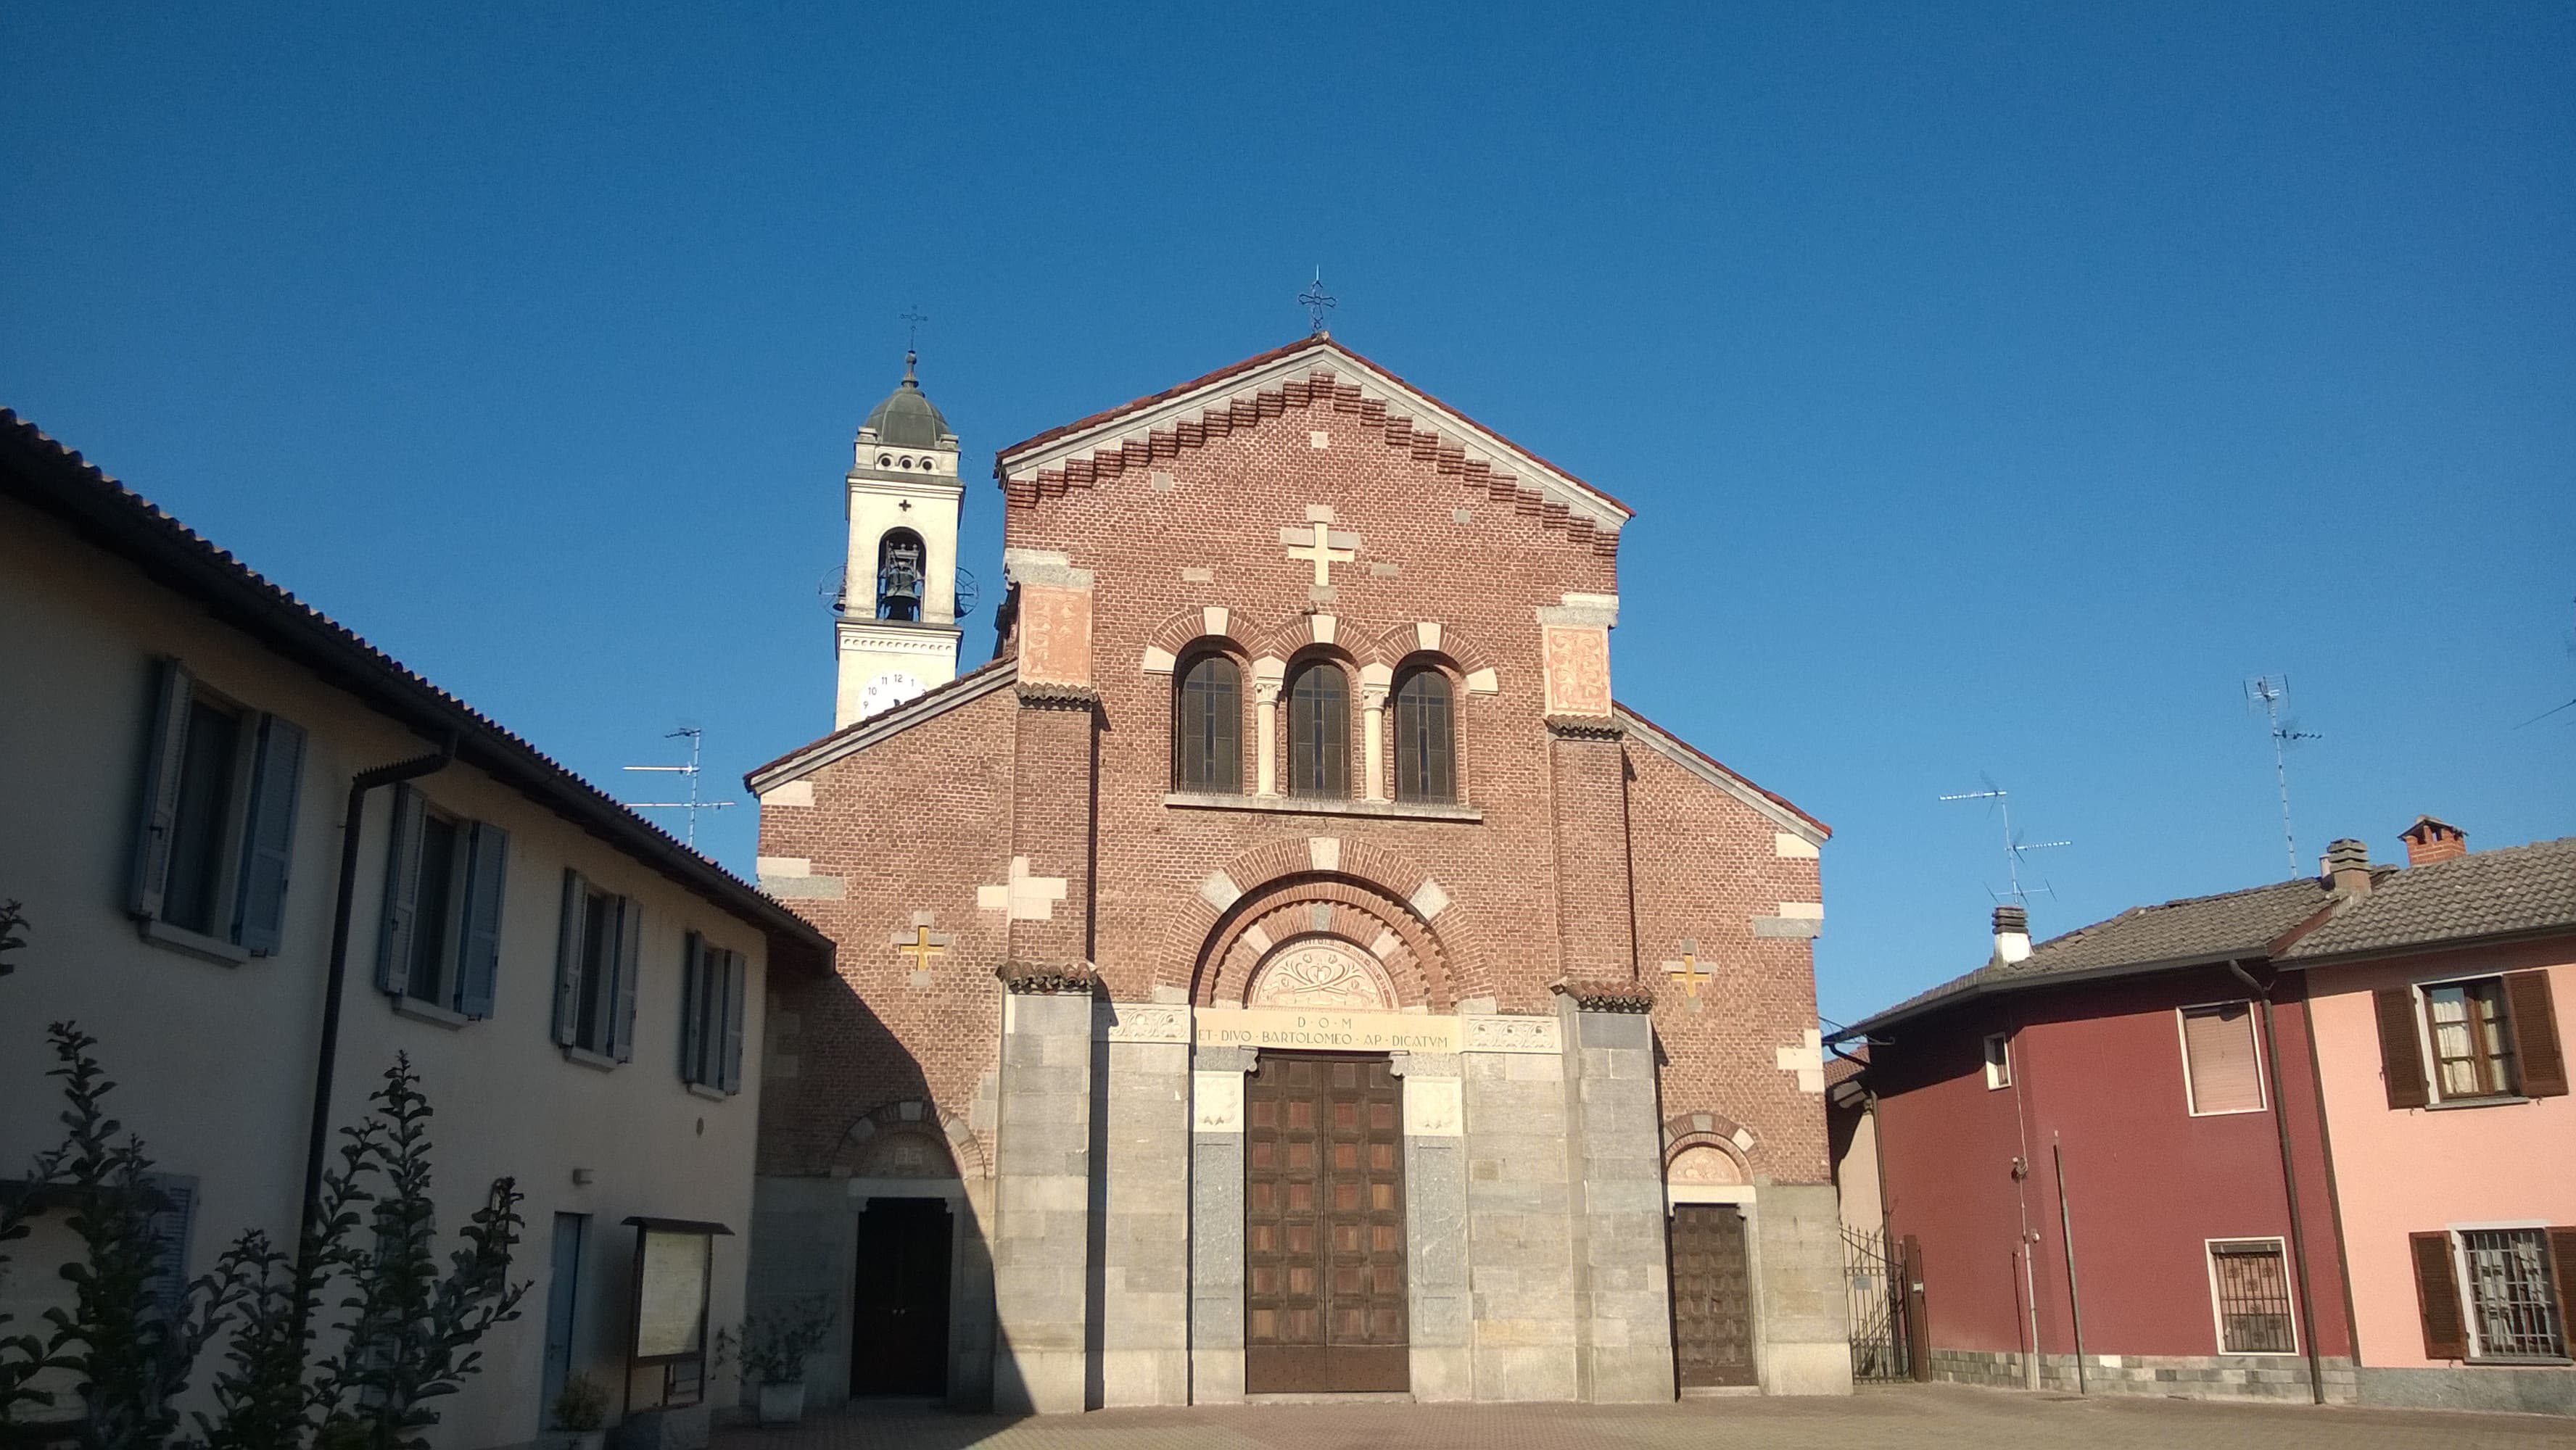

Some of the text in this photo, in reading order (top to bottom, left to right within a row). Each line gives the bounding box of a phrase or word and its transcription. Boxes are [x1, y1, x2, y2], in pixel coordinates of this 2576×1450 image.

[881, 676, 888, 685] 11
[894, 674, 903, 683] 12
[911, 679, 915, 687] 1
[868, 687, 878, 696] 10
[863, 701, 869, 710] 9
[1198, 1030, 1448, 1048] ET DIVO BARTOLOMEO AP DICATVM
